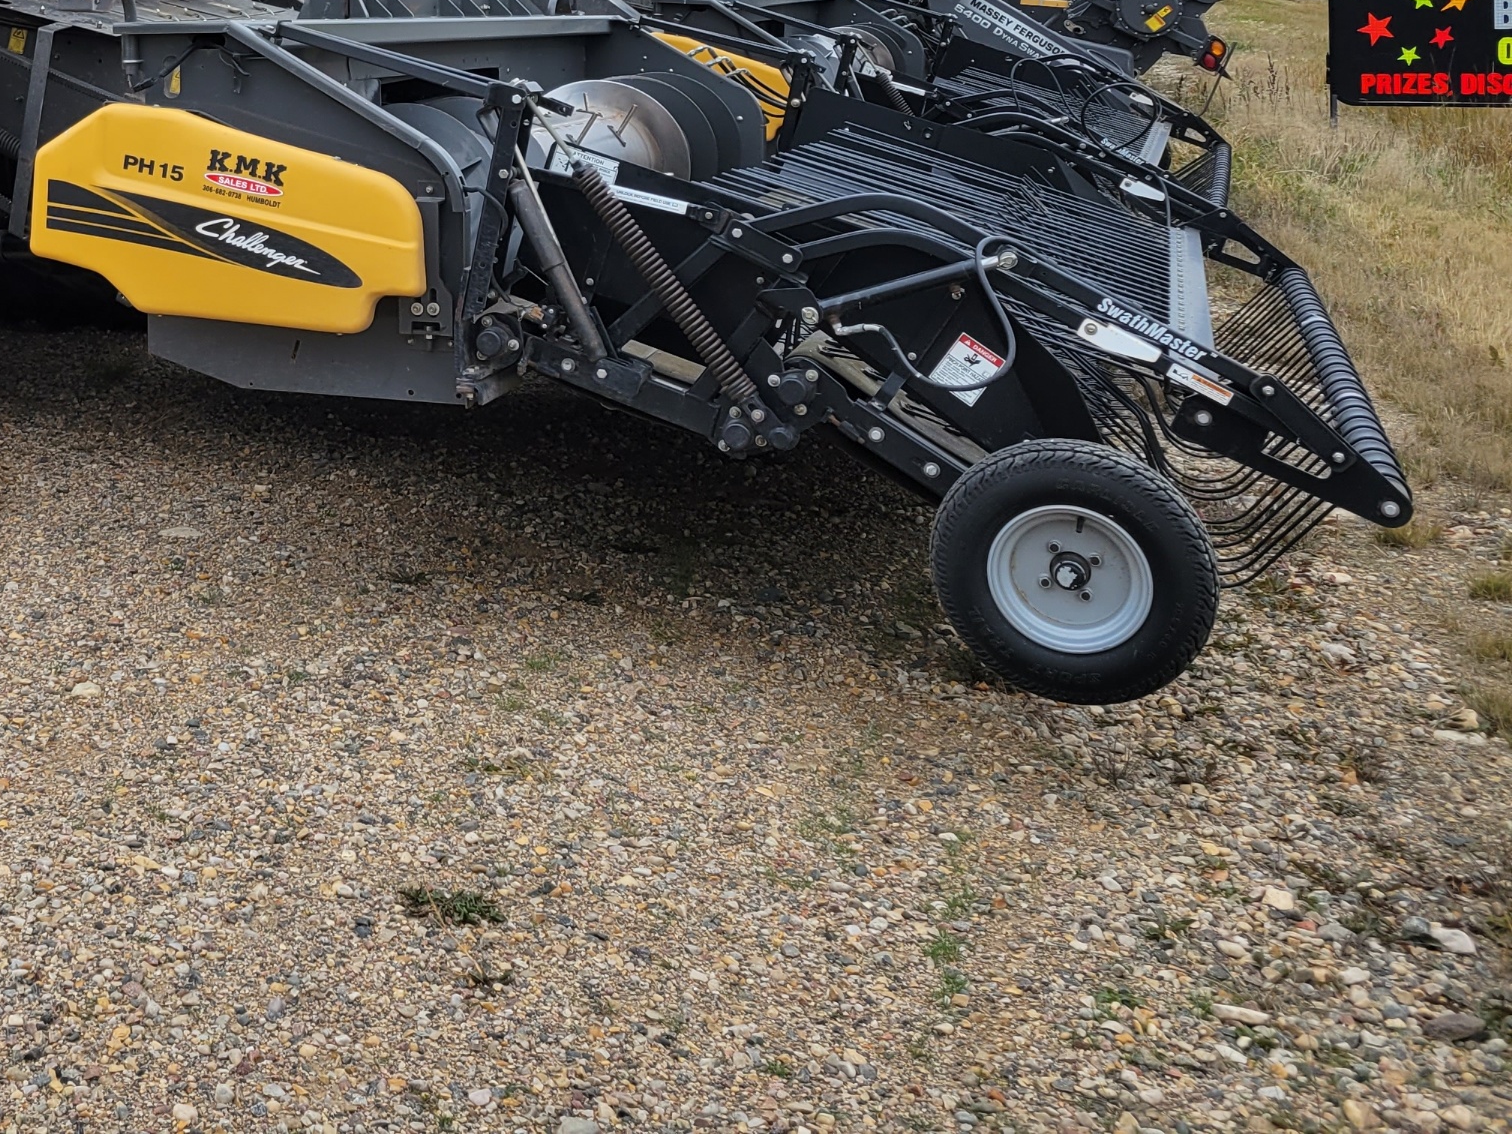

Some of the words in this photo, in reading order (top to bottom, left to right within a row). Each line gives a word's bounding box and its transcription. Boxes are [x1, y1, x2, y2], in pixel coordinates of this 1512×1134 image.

[954, 3, 992, 29] 5400
[123, 154, 155, 176] PH
[159, 163, 185, 182] 15
[218, 176, 248, 189] SALES
[246, 194, 281, 208] HUMBOLDT
[195, 218, 321, 275] Challenger
[972, 344, 998, 363] DANGER
